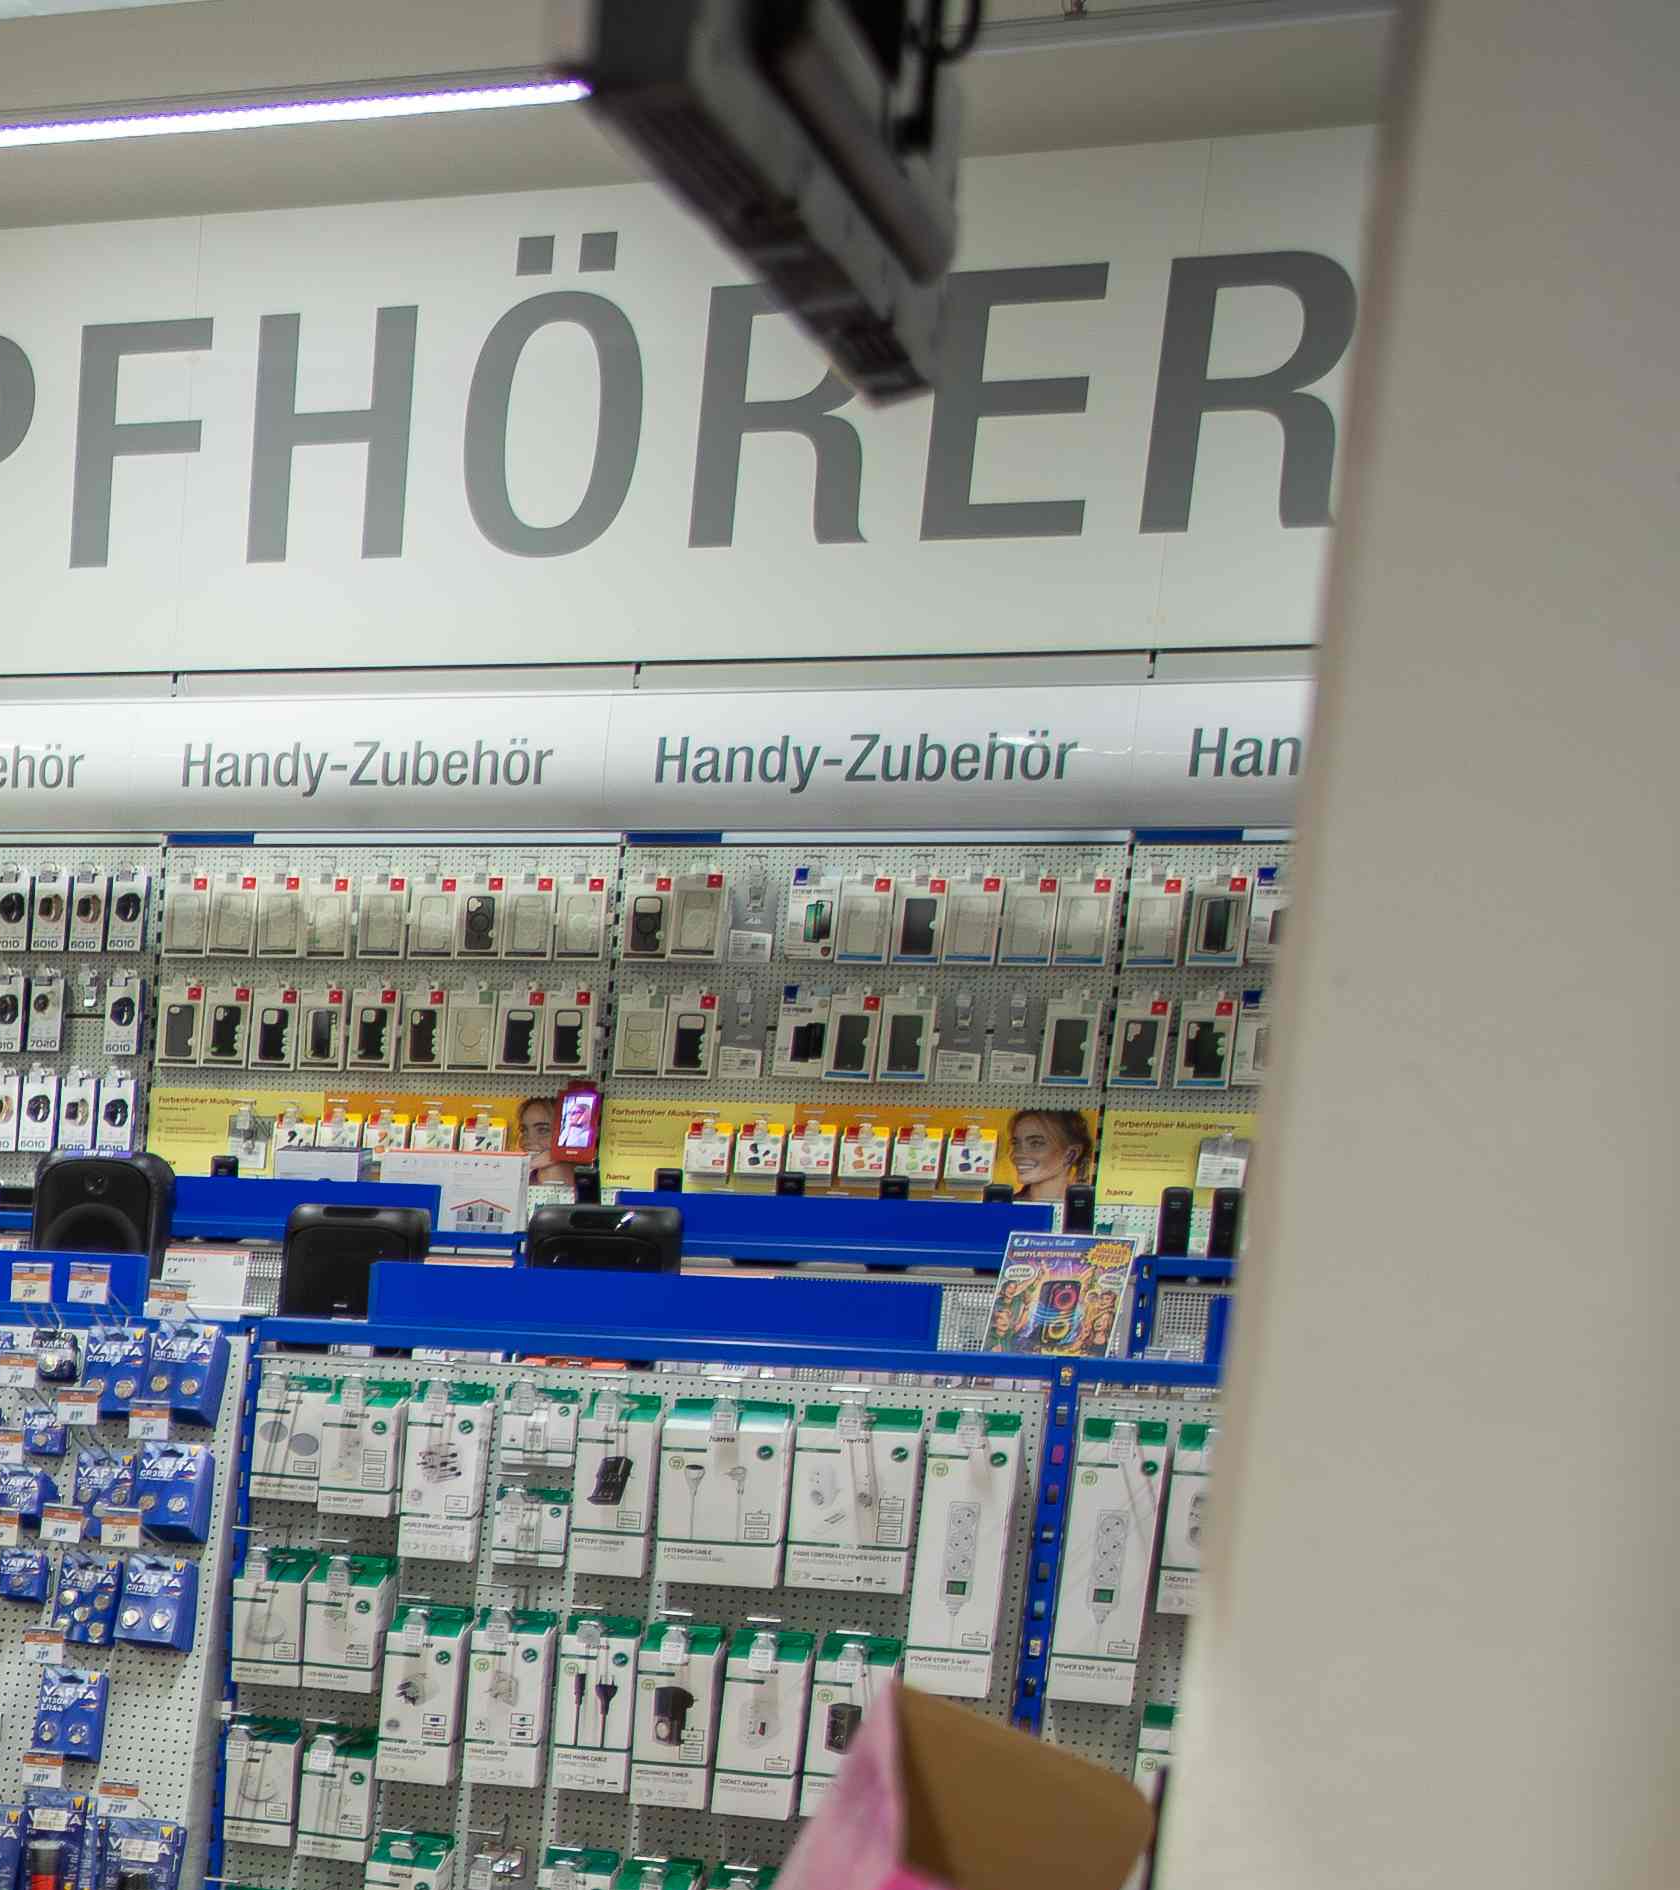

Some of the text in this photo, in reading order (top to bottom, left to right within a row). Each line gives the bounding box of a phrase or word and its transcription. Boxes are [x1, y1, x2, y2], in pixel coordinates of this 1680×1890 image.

[181, 737, 554, 799] Handy-Zubehör
[654, 729, 1078, 793] Handy-Zubehör
[88, 1343, 142, 1356] VARTA
[142, 1458, 196, 1472] VARTA
[43, 1683, 96, 1701] VARTA
